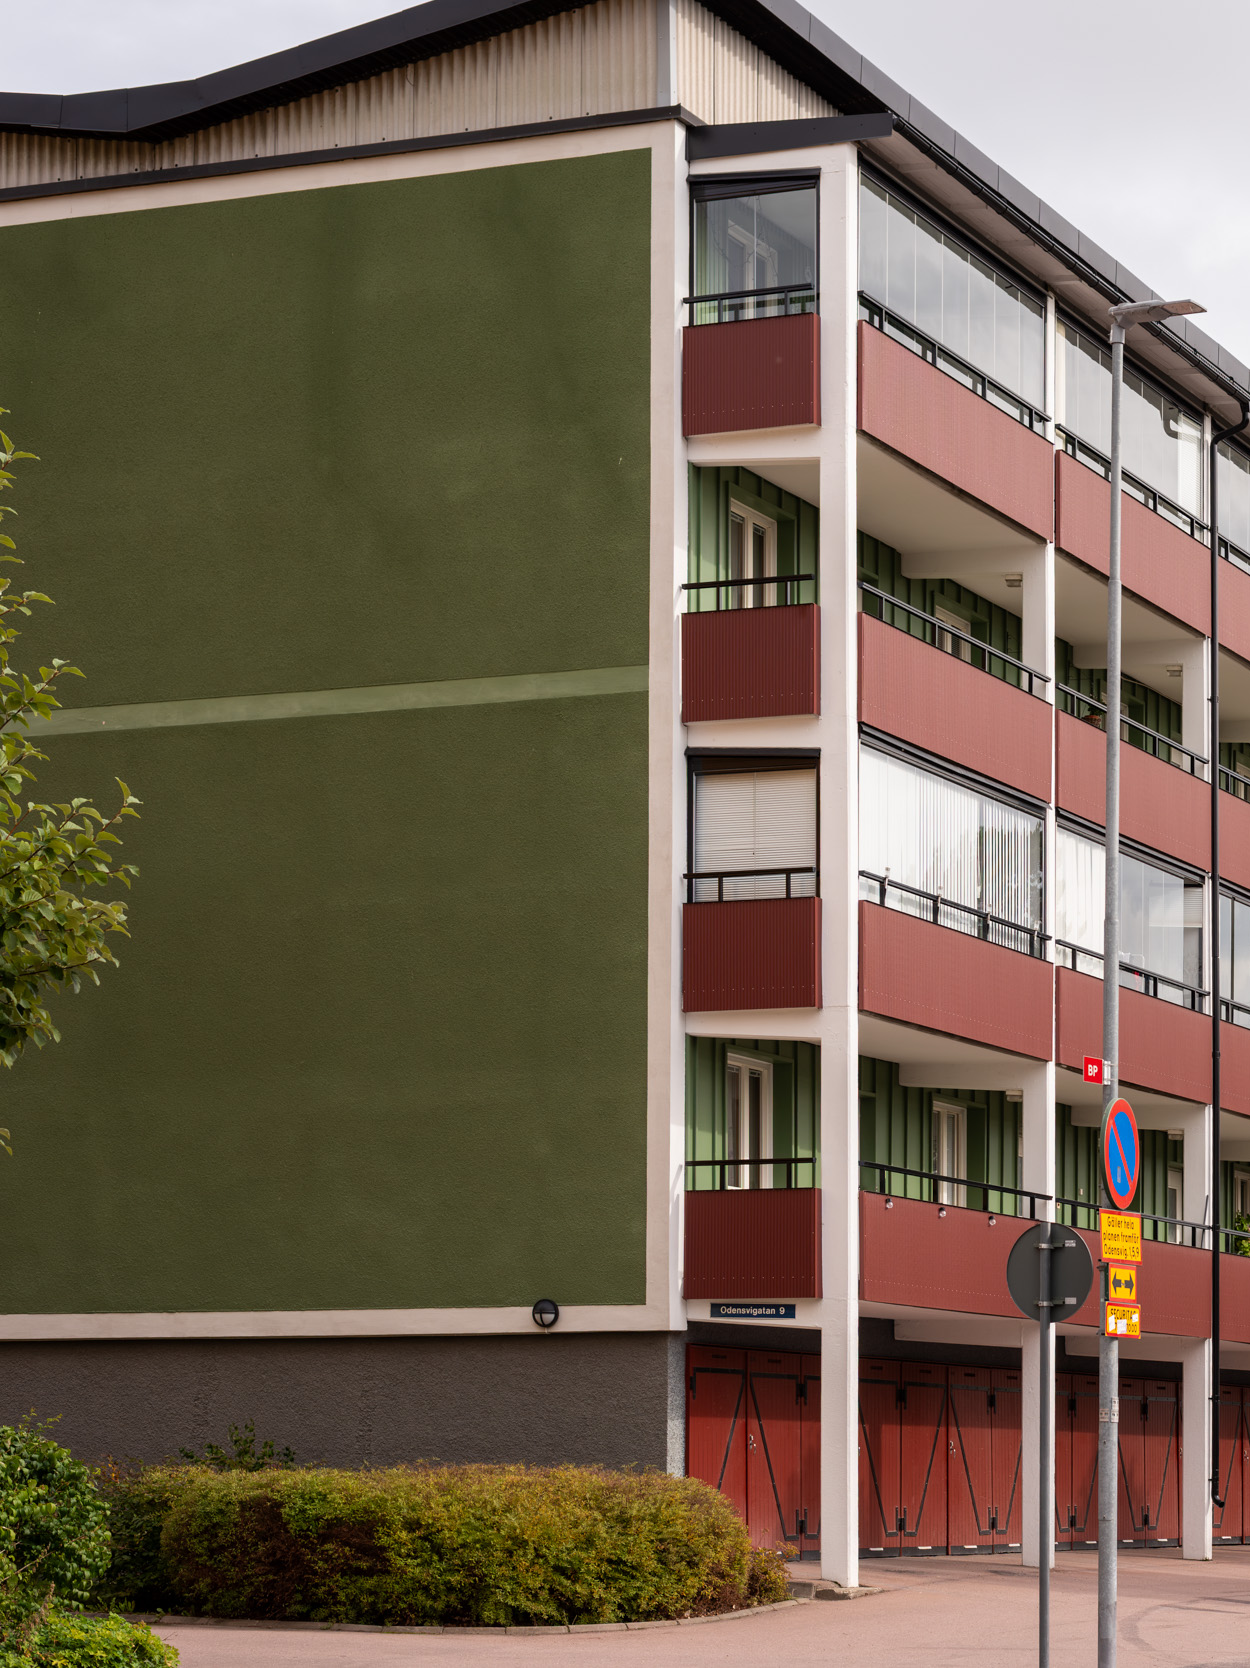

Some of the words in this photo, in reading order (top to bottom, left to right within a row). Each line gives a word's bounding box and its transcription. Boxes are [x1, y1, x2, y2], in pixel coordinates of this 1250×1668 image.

[1088, 1064, 1098, 1077] BP
[1124, 1218, 1134, 1230] hela
[1103, 1230, 1120, 1243] planen
[1121, 1232, 1139, 1244] framför
[720, 1306, 775, 1316] Odensvigatan
[779, 1306, 785, 1315] 9
